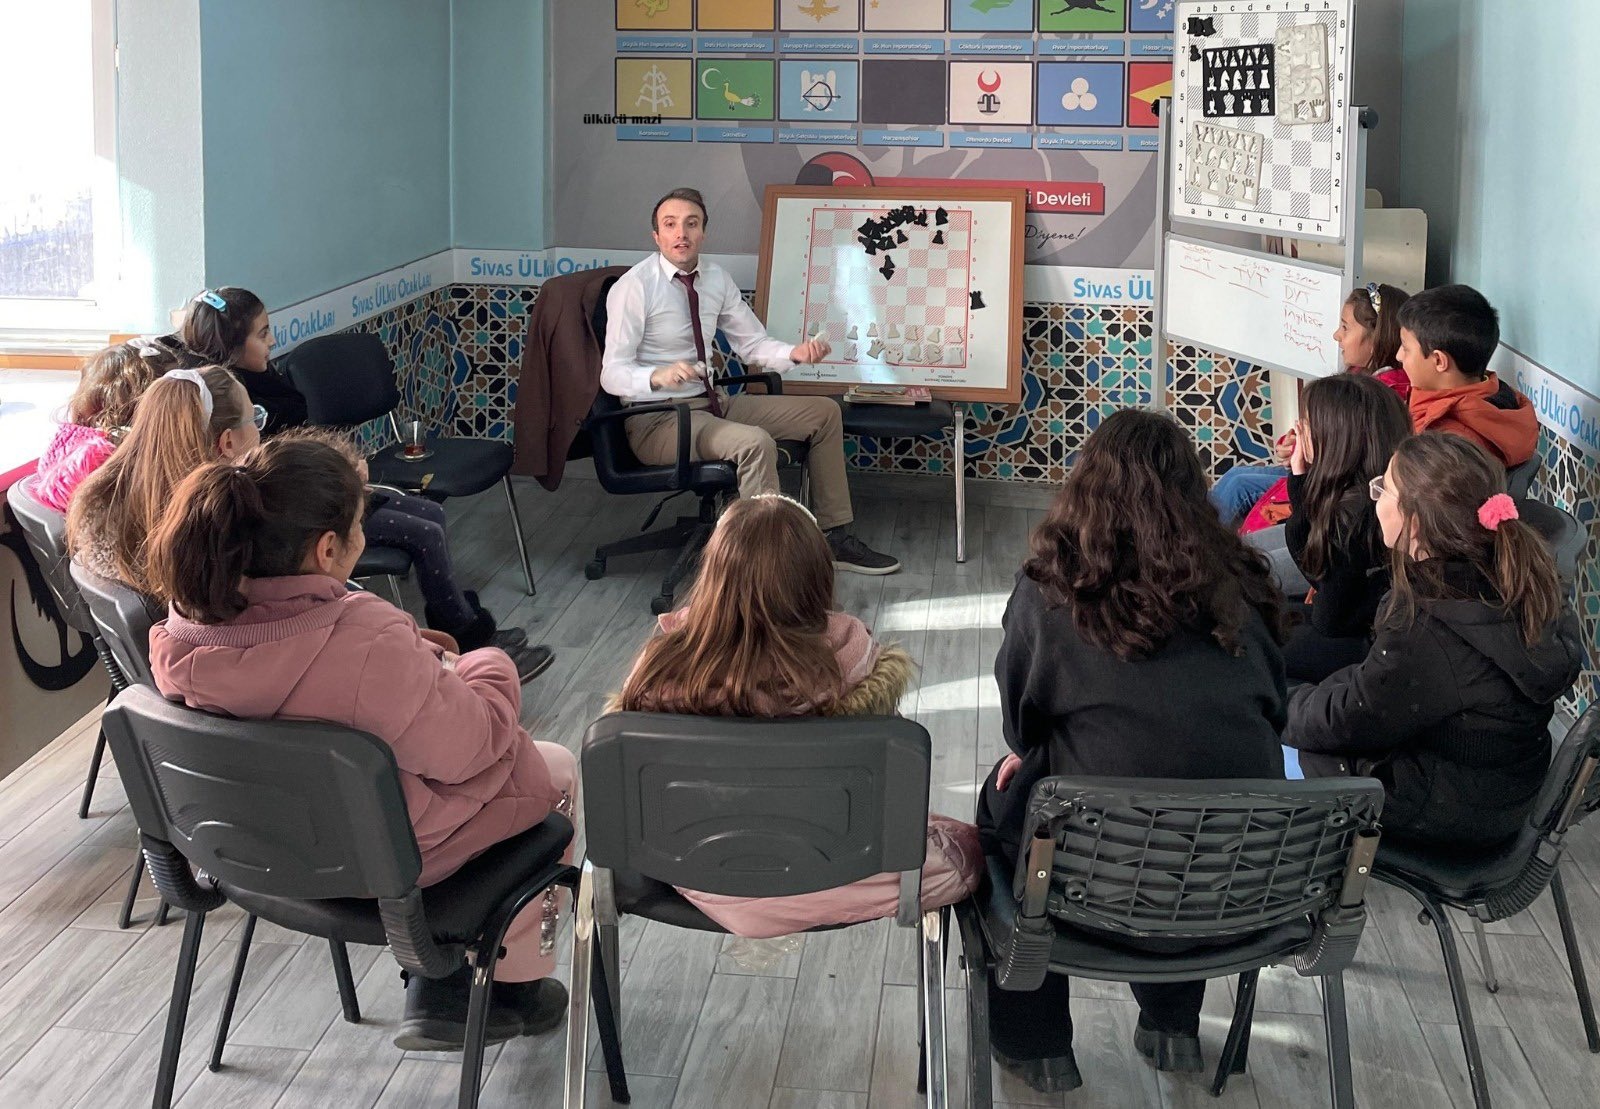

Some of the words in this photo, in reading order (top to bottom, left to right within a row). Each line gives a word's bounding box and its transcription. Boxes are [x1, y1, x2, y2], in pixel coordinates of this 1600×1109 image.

[1340, 20, 1345, 28] 8
[1340, 47, 1345, 55] 7
[1338, 73, 1343, 81] 6
[1338, 99, 1342, 108] 5
[1036, 191, 1091, 206] Devleti
[1298, 223, 1303, 231] g
[1317, 224, 1322, 232] h
